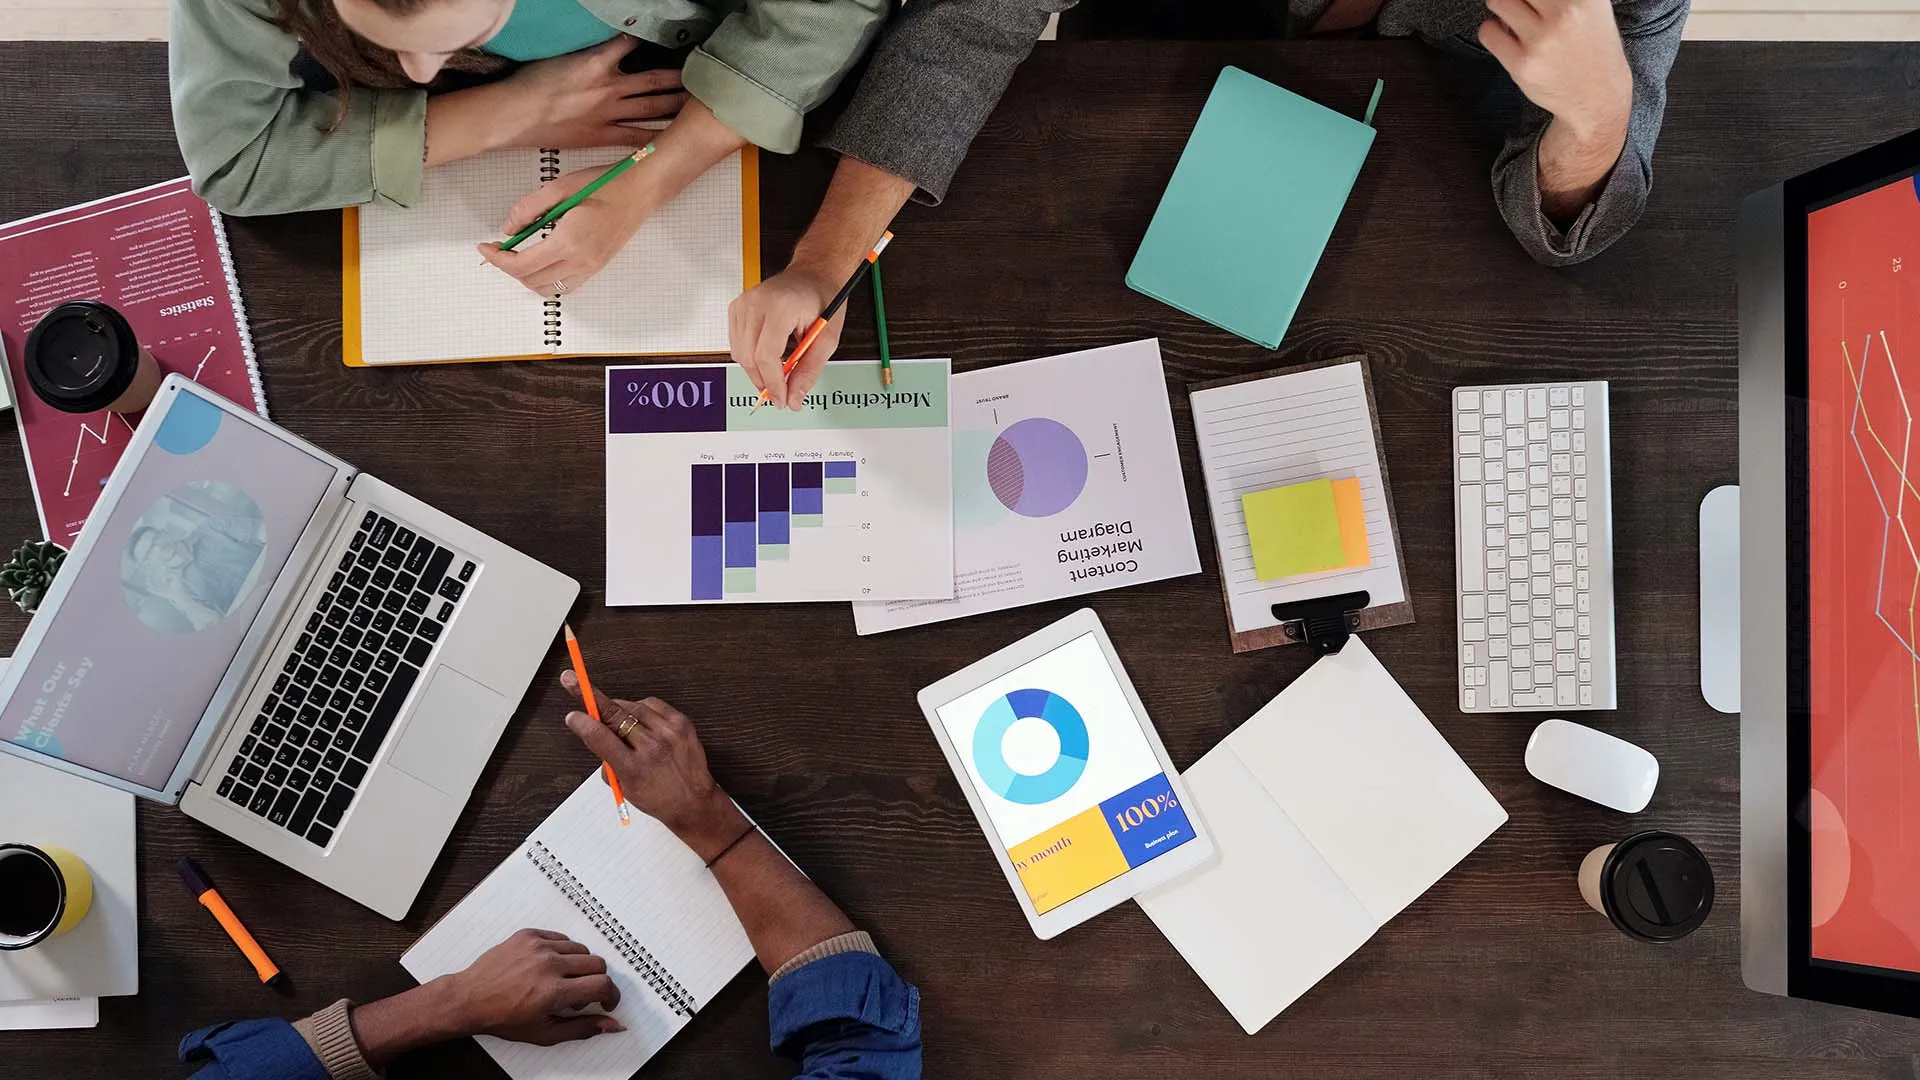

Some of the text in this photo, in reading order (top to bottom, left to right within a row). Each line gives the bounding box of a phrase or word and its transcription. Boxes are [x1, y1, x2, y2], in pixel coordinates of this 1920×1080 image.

[1892, 257, 1902, 273] 25
[160, 296, 215, 317] Statistics
[627, 380, 712, 408] 100%
[832, 390, 931, 410] Marketing
[700, 450, 854, 460] January February March April May
[1118, 455, 1126, 482] CUSTOMER
[1060, 521, 1133, 543] Diagram
[1057, 538, 1143, 563] Marketing
[1069, 560, 1138, 582] Content
[13, 661, 67, 741] What Our
[34, 656, 94, 748] Clients Say
[1115, 790, 1177, 833] 100%
[1030, 836, 1072, 864] month
[1144, 829, 1179, 849] Business plan
